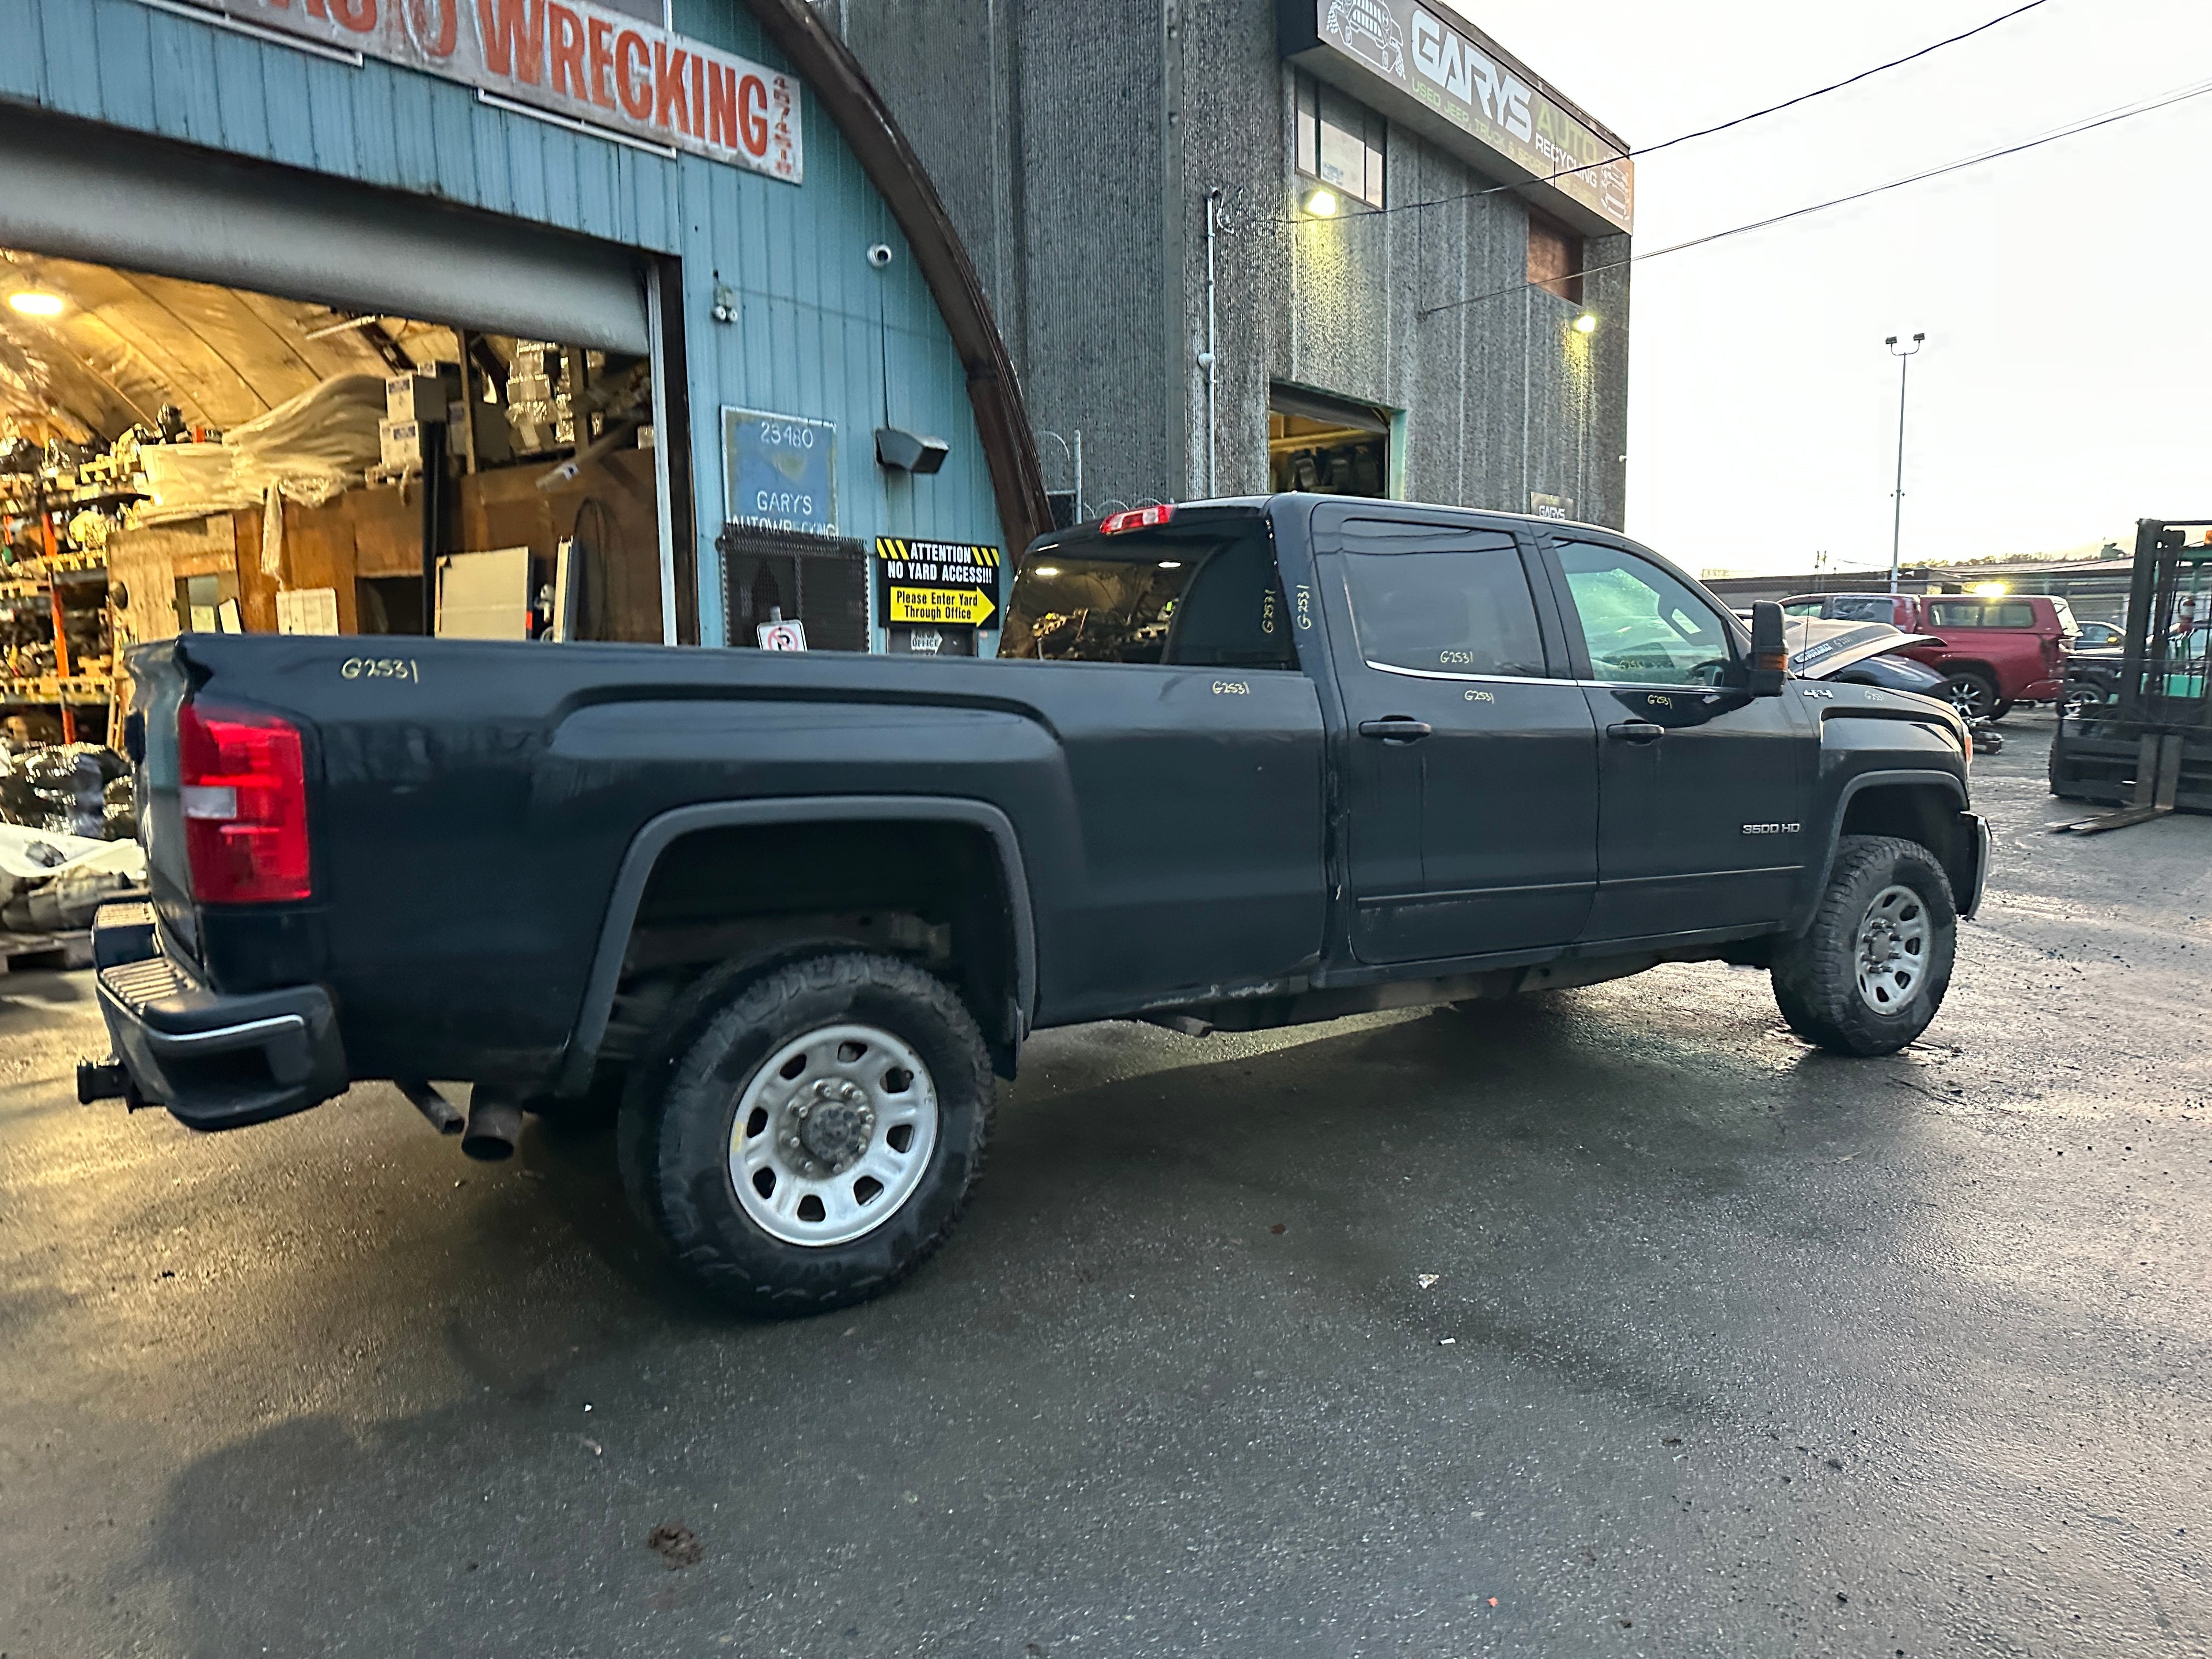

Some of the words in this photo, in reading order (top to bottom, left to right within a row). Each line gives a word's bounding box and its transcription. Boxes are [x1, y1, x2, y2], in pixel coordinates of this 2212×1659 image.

[477, 0, 768, 157] WRECKING
[1412, 9, 1532, 143] GARYS
[1412, 77, 1441, 108] USED
[1475, 118, 1505, 150] TRUCK
[1536, 102, 1597, 165] AUTO
[1535, 132, 1597, 188] RECYCLING
[760, 421, 813, 449] 23480
[756, 490, 812, 516] GARY'S
[1539, 505, 1565, 520] GARYS
[910, 541, 971, 563] ATTENTION
[888, 560, 903, 579] NO
[908, 562, 937, 581] YARD
[942, 565, 992, 584] ACCESS!!!
[896, 590, 927, 604] Please
[931, 592, 955, 605] Enter
[959, 593, 978, 606] Yard
[1296, 584, 1312, 630] G2531
[904, 605, 941, 620] Through
[945, 607, 971, 619] Office
[1440, 650, 1473, 664] G2531
[341, 657, 419, 684] G2531
[1212, 681, 1250, 695] G2531
[1464, 690, 1494, 704] G2531
[1743, 824, 1779, 834] 3500
[1781, 823, 1800, 833] HD
